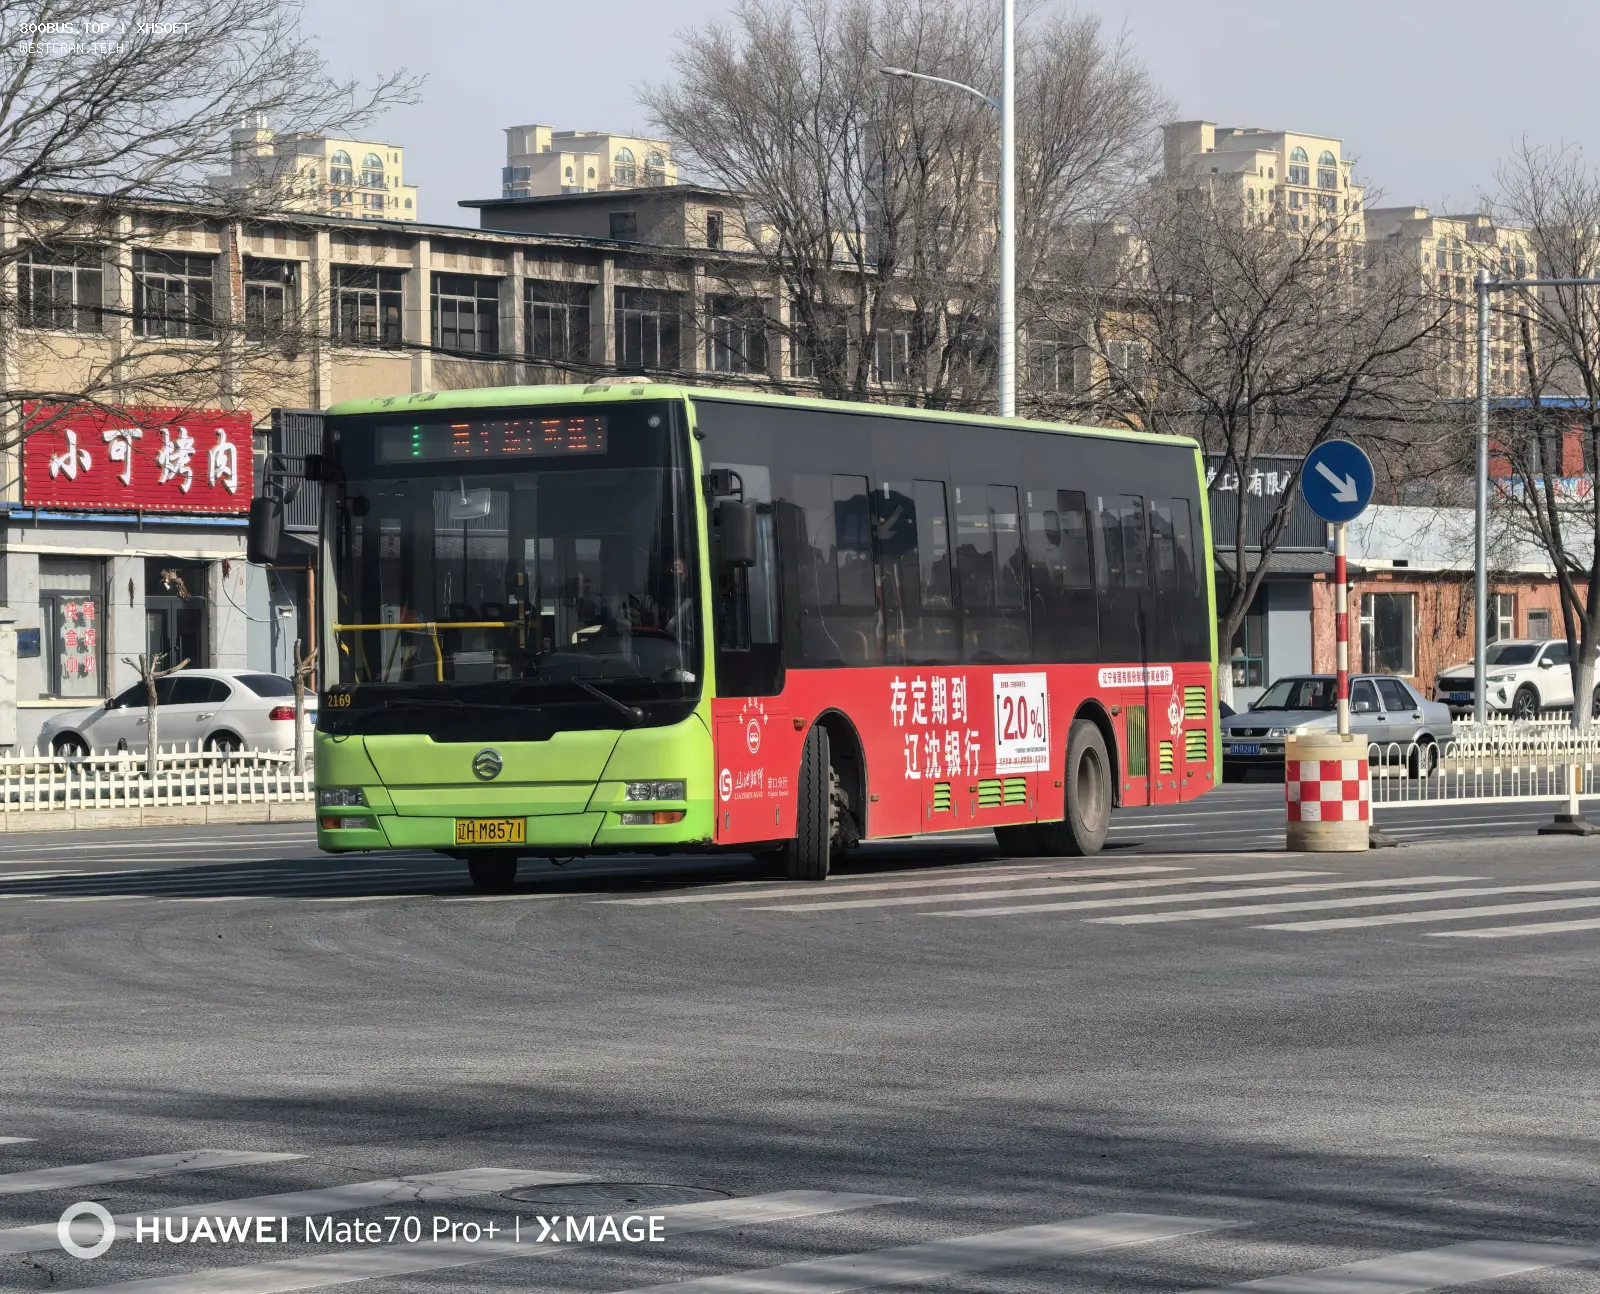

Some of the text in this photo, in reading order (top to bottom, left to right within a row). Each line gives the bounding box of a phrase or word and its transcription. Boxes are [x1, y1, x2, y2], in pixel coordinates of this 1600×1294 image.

[50, 427, 239, 495] 小可烤肉
[65, 601, 95, 620] 快餐
[65, 629, 96, 647] 盒饭
[66, 656, 96, 673] 小炒
[327, 694, 352, 708] 2169
[890, 675, 968, 727] 存定期到
[904, 728, 981, 781] 辽沈银行
